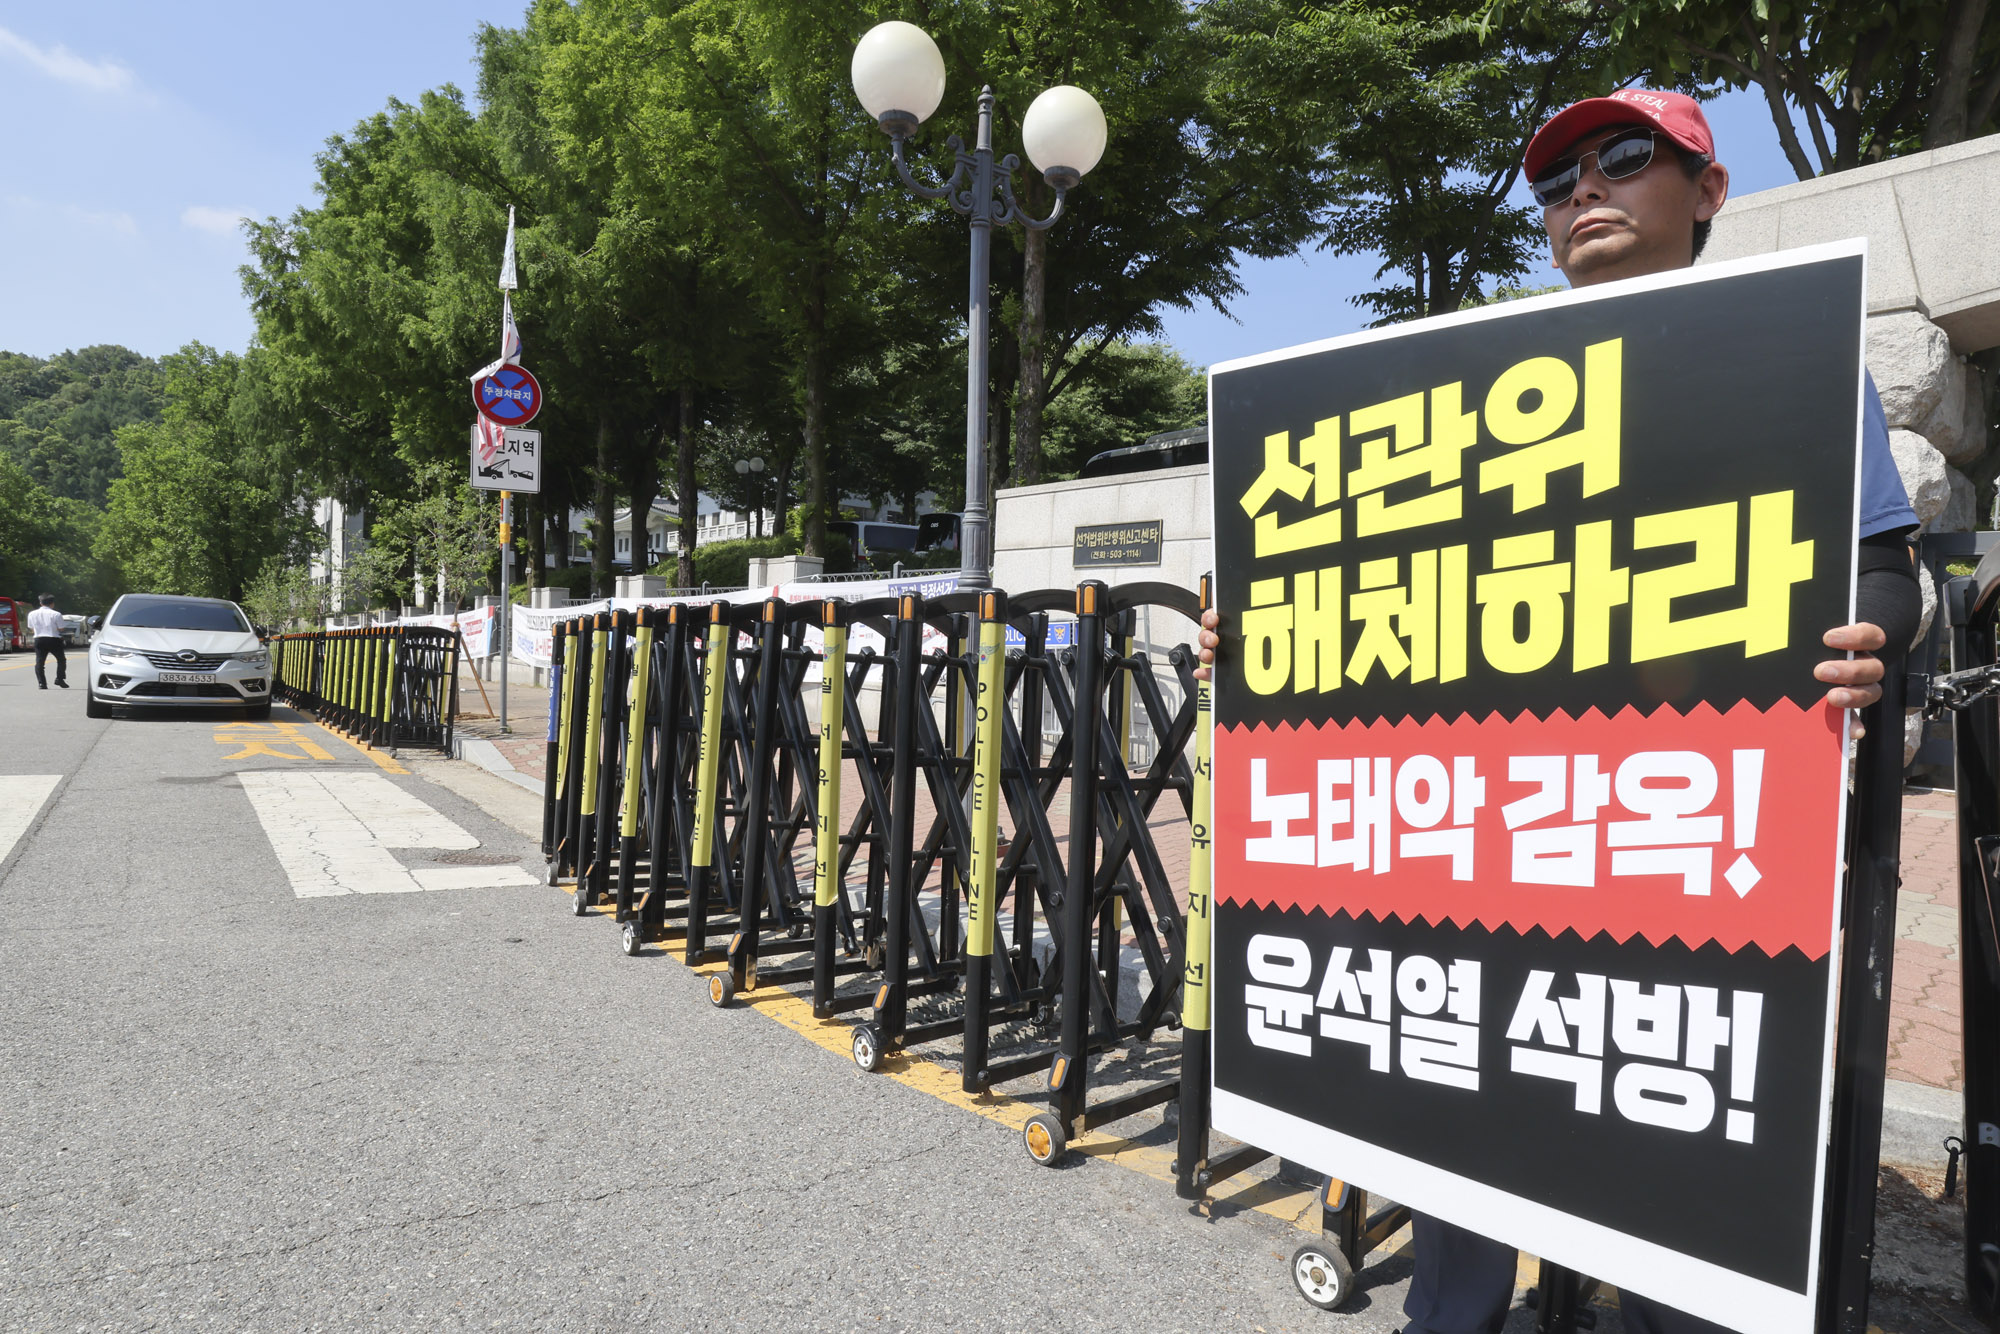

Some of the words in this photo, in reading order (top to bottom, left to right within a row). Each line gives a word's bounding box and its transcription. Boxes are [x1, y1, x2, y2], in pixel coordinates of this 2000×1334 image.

[1630, 93, 1668, 111] STEAL
[484, 386, 532, 401] 주정차금지
[496, 438, 535, 457] 지역
[1239, 337, 1623, 559] 선관위
[1075, 527, 1159, 548] 선거법위반행위신고센타
[1242, 490, 1814, 696] 해체하라
[188, 675, 212, 683] 4533
[974, 682, 988, 811] POLICE
[1245, 754, 1485, 881] 노태악
[1501, 749, 1765, 899] 감옥!
[969, 837, 980, 921] LINE
[1244, 933, 1482, 1091] 윤석열
[1505, 969, 1763, 1144] 석방!
